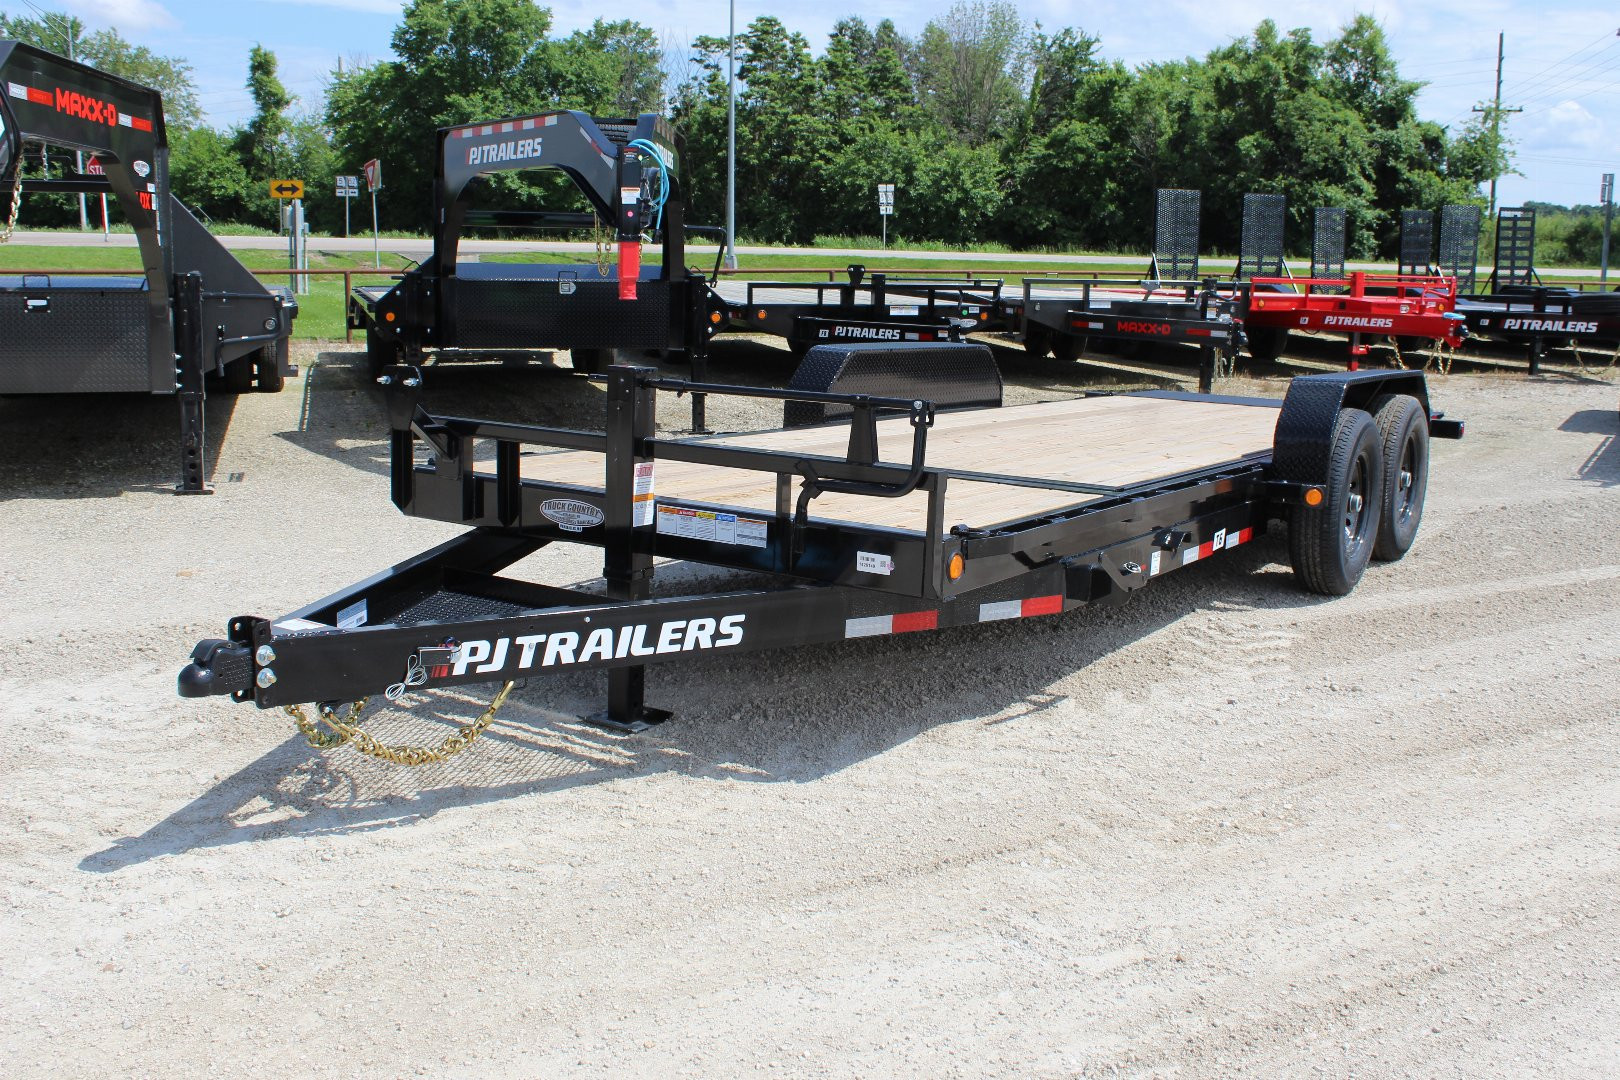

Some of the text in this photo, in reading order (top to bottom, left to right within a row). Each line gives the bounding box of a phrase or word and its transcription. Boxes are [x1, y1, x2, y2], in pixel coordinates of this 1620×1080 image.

[469, 138, 543, 165] PJ TRAILERS
[1324, 316, 1393, 328] PJ TRAILERS
[1504, 319, 1598, 333] PJ TRAILERS
[834, 326, 900, 340] PJ TRAILERS
[544, 501, 599, 517] TRUCK COUNTRY
[452, 614, 746, 676] PJ TRAILERS
